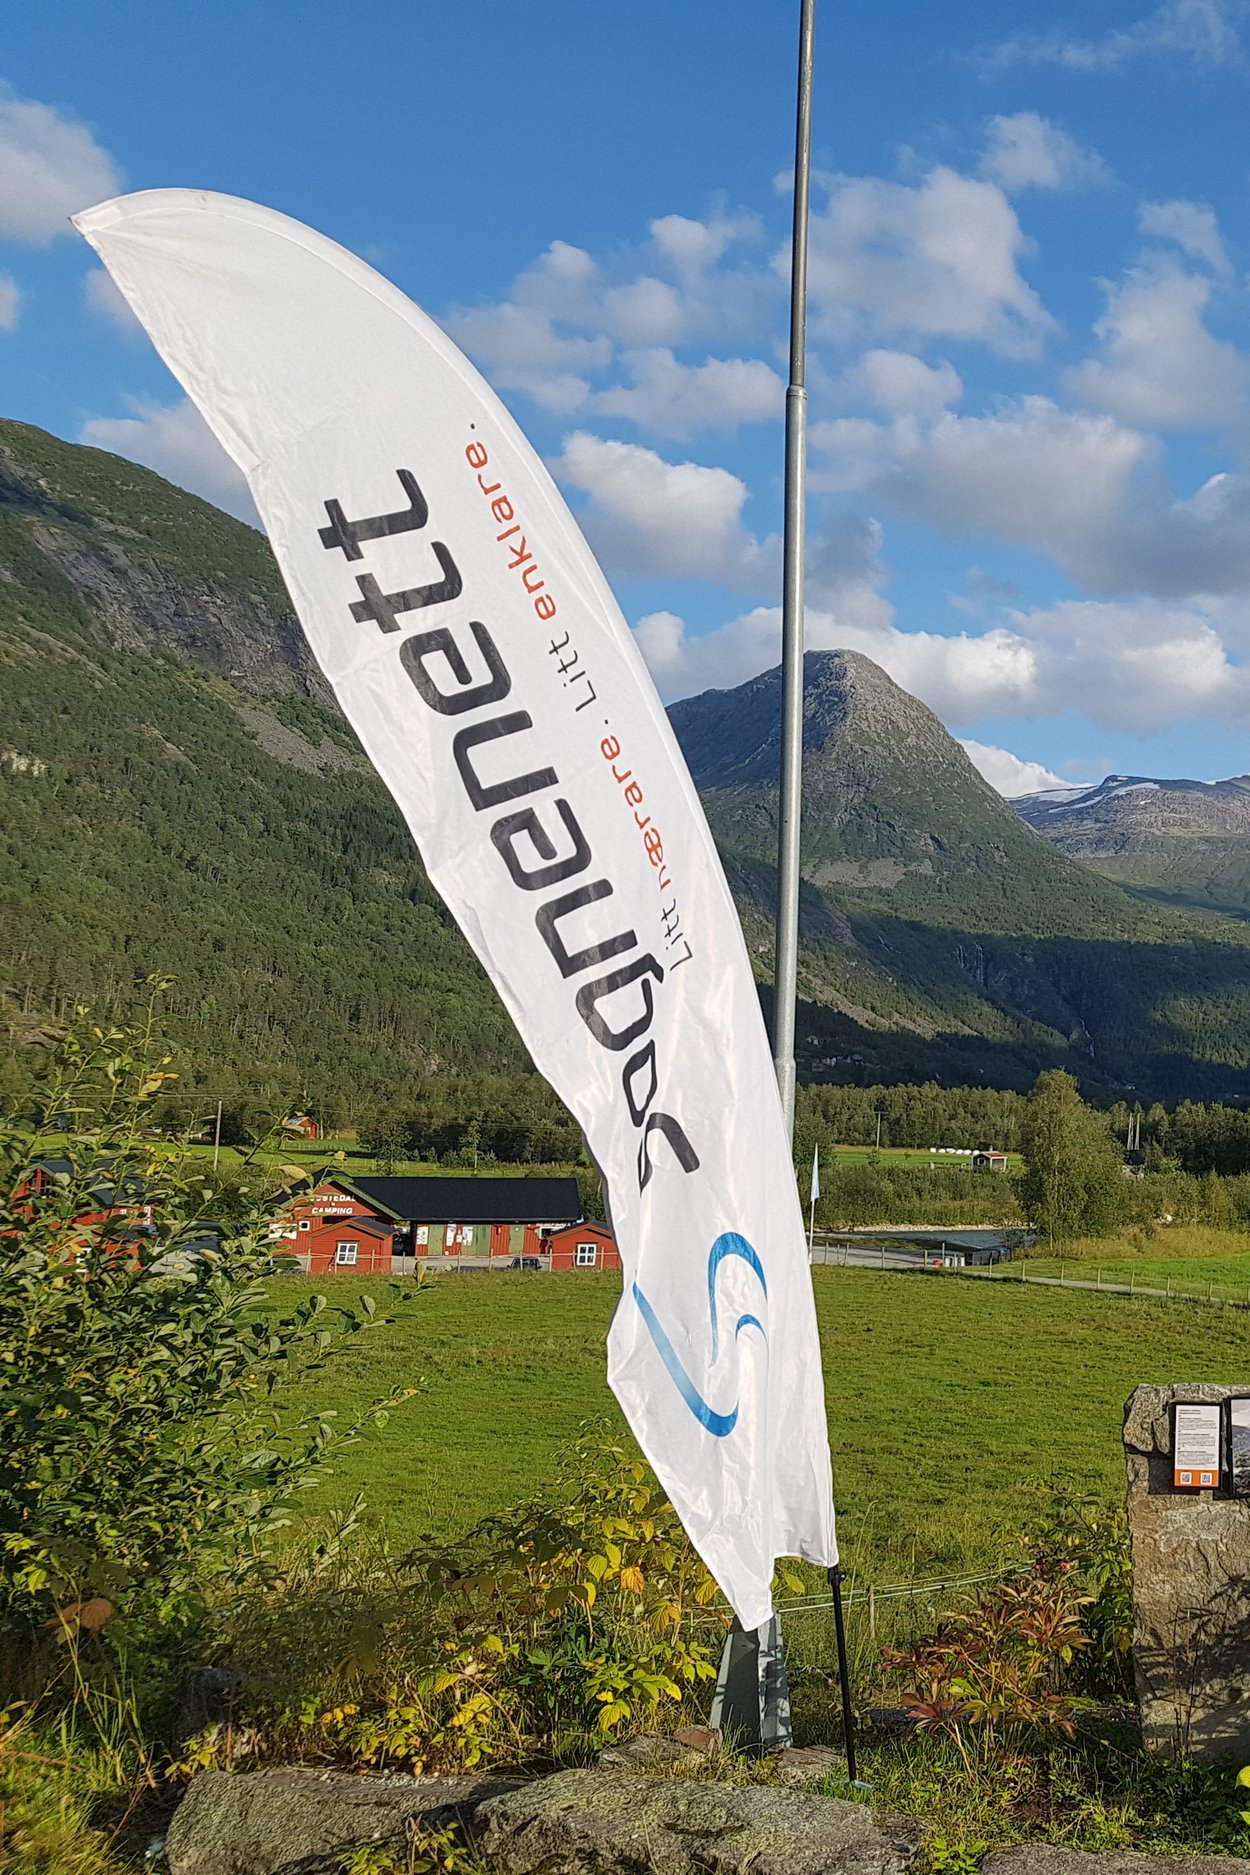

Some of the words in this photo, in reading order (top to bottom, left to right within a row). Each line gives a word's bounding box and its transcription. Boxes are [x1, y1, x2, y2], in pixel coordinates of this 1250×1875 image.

[465, 422, 557, 621] enklare.
[547, 630, 597, 712] Litt
[318, 468, 700, 1198] Sognenett
[600, 718, 672, 892] nærare.
[659, 898, 694, 972] Litt
[309, 1194, 356, 1202] STEDAL
